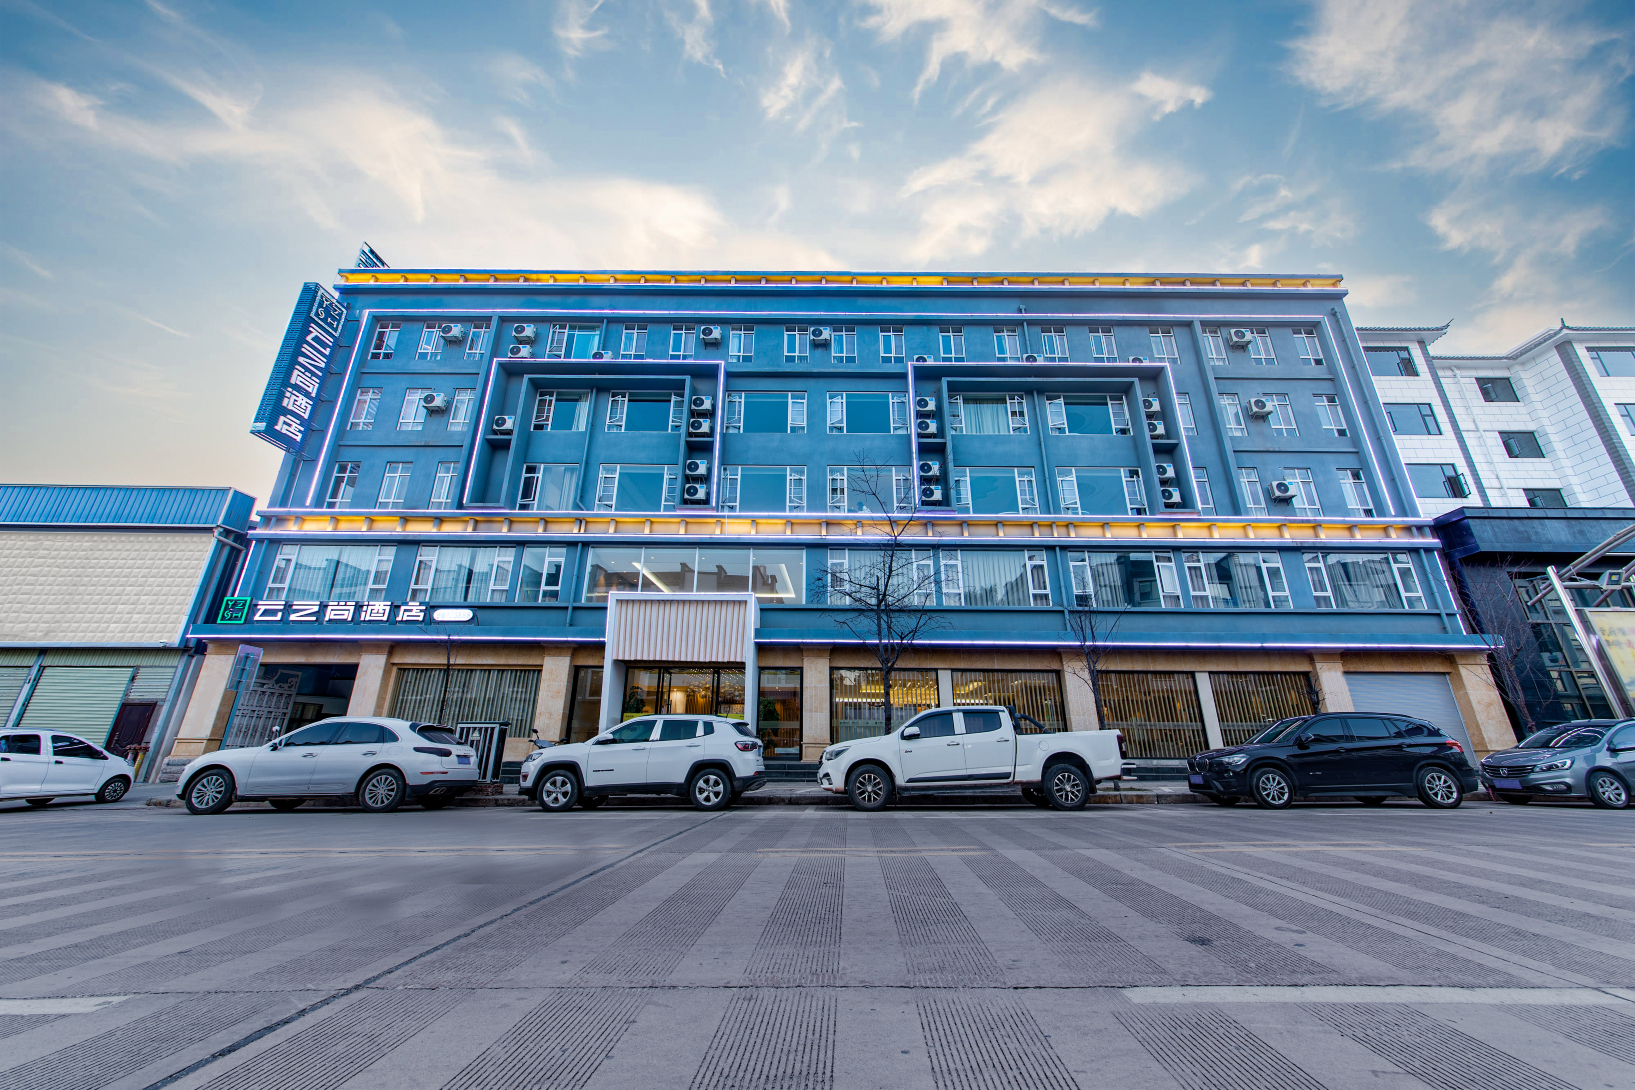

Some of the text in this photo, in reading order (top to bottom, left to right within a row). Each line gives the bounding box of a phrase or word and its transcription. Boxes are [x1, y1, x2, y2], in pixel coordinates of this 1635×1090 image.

[273, 322, 334, 442] 云之尚酒店
[253, 600, 426, 621] 云之尚酒店
